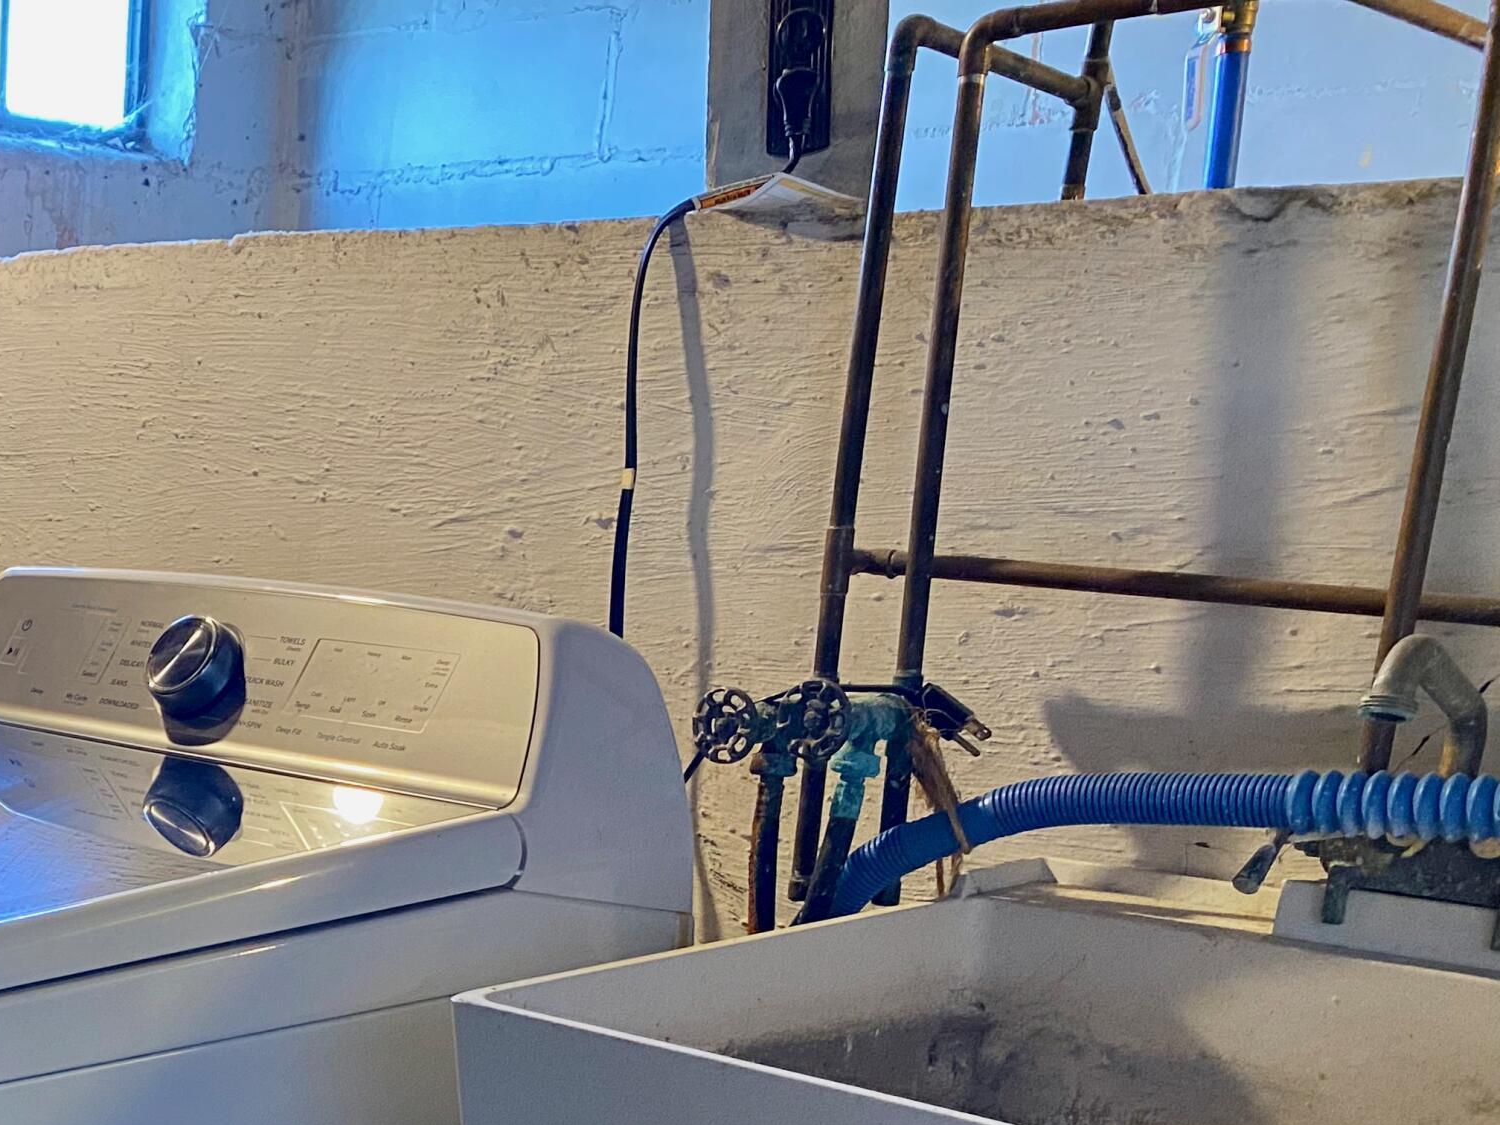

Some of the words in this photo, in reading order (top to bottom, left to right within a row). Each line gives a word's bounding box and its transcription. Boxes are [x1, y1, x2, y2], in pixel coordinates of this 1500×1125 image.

[280, 636, 306, 646] TOWELS
[119, 658, 145, 668] DELICAT
[273, 657, 295, 667] BULKY
[336, 735, 361, 745] Control
[372, 740, 388, 750] Auto
[389, 743, 406, 752] Soak
